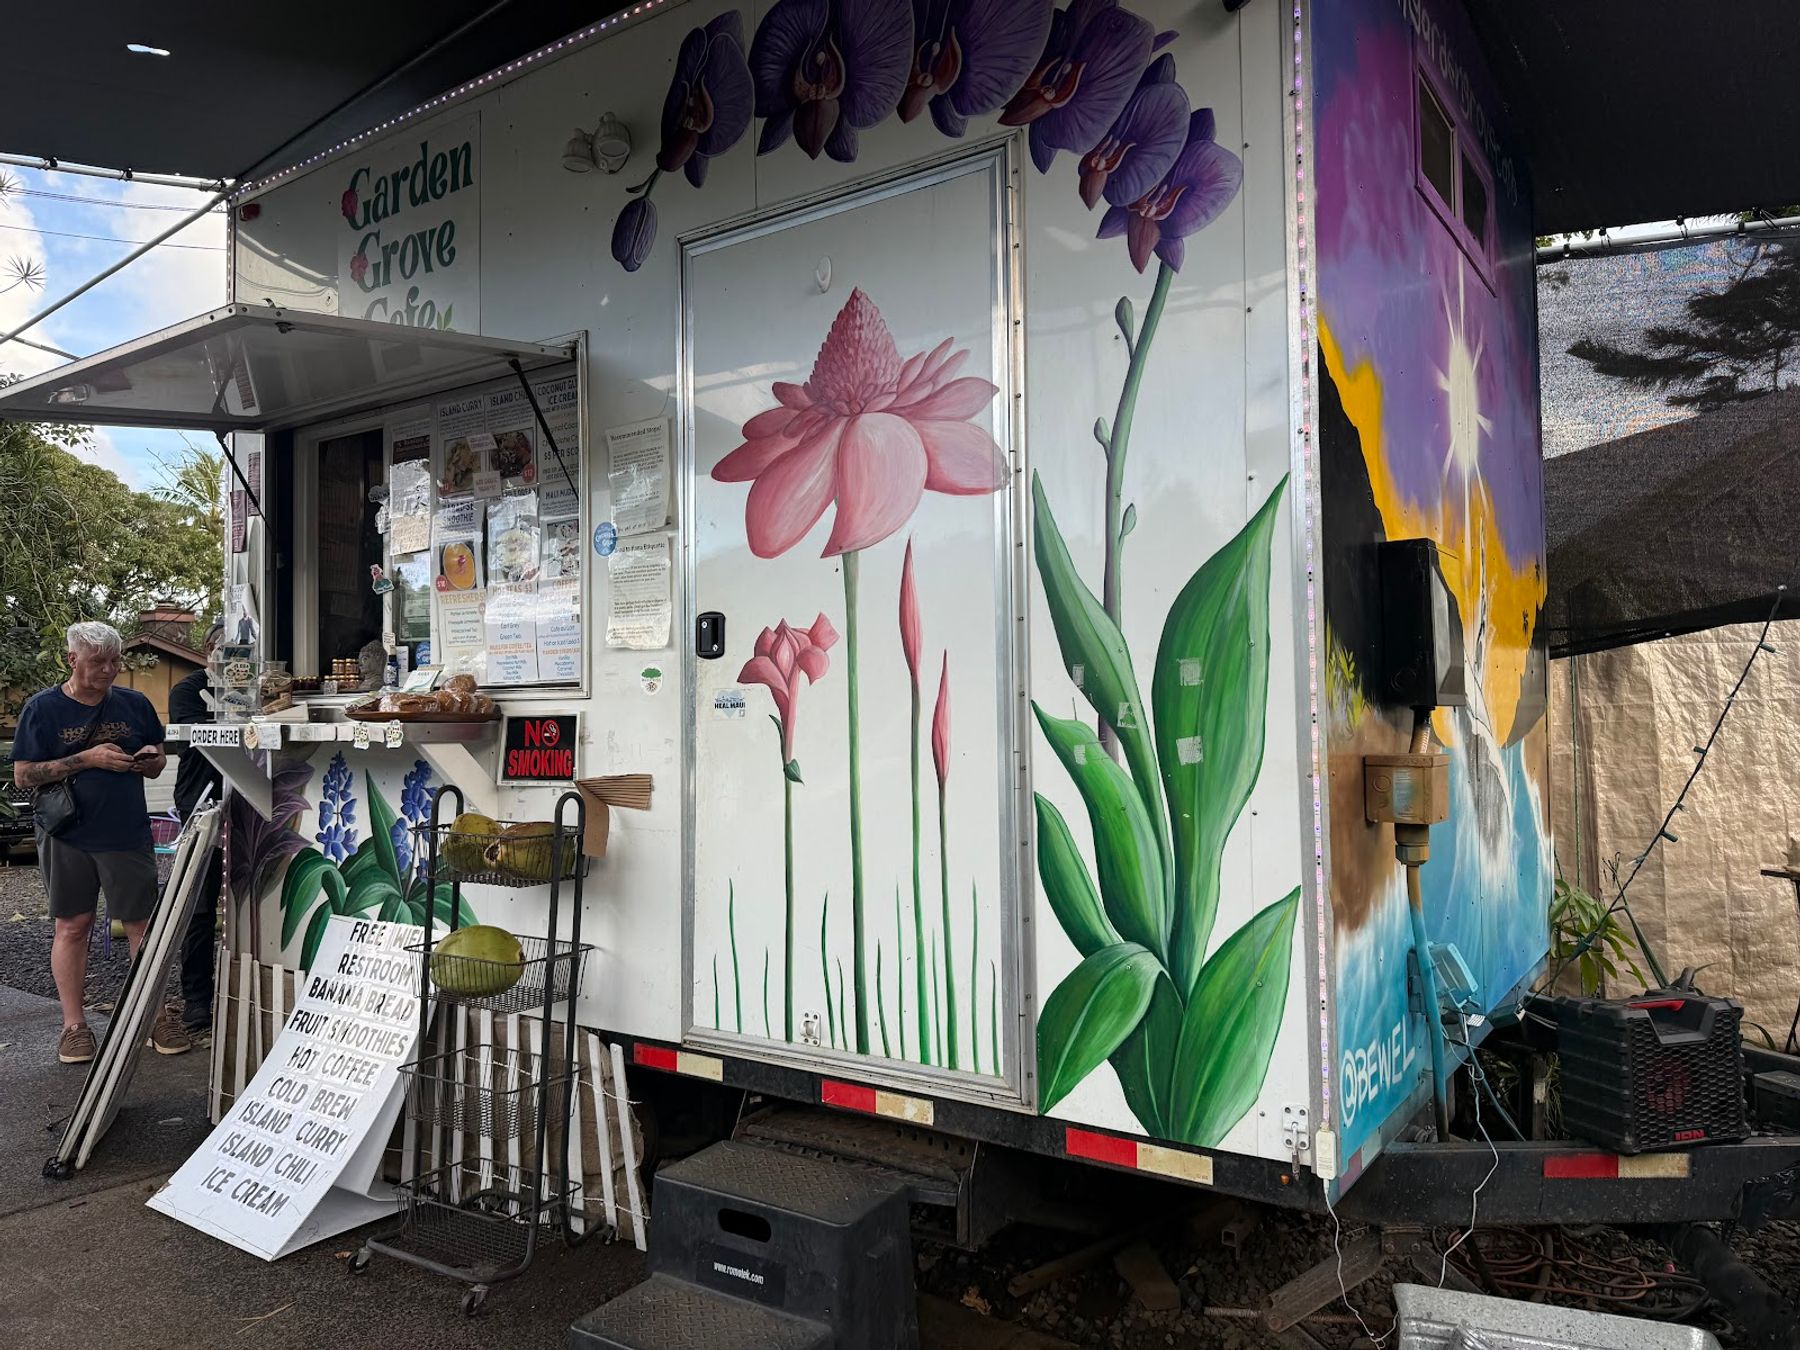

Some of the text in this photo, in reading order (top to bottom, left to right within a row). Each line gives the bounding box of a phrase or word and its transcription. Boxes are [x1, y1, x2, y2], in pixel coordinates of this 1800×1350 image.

[344, 140, 474, 231] Garden
[353, 219, 456, 293] Grove
[440, 398, 482, 417] ISLAND CURRY
[490, 392, 513, 407] ISLAND
[192, 729, 218, 744] ORDER
[220, 729, 239, 744] HERE
[524, 719, 560, 747] NO
[507, 749, 573, 777] SMOKING
[350, 921, 387, 946] FREE
[308, 977, 416, 1021] BANANA BREAD
[288, 1009, 409, 1058] FRUIT SMOOTHIES
[287, 1047, 379, 1086] HOT COFFEE
[1341, 1014, 1416, 1129] @BEWEL
[267, 1076, 359, 1121] COLD BREW
[238, 1099, 348, 1156] ISLAND CURRY
[1673, 1128, 1705, 1142] ION
[217, 1131, 318, 1185] ISLAND CHILI
[200, 1166, 292, 1218] ICE CREAM
